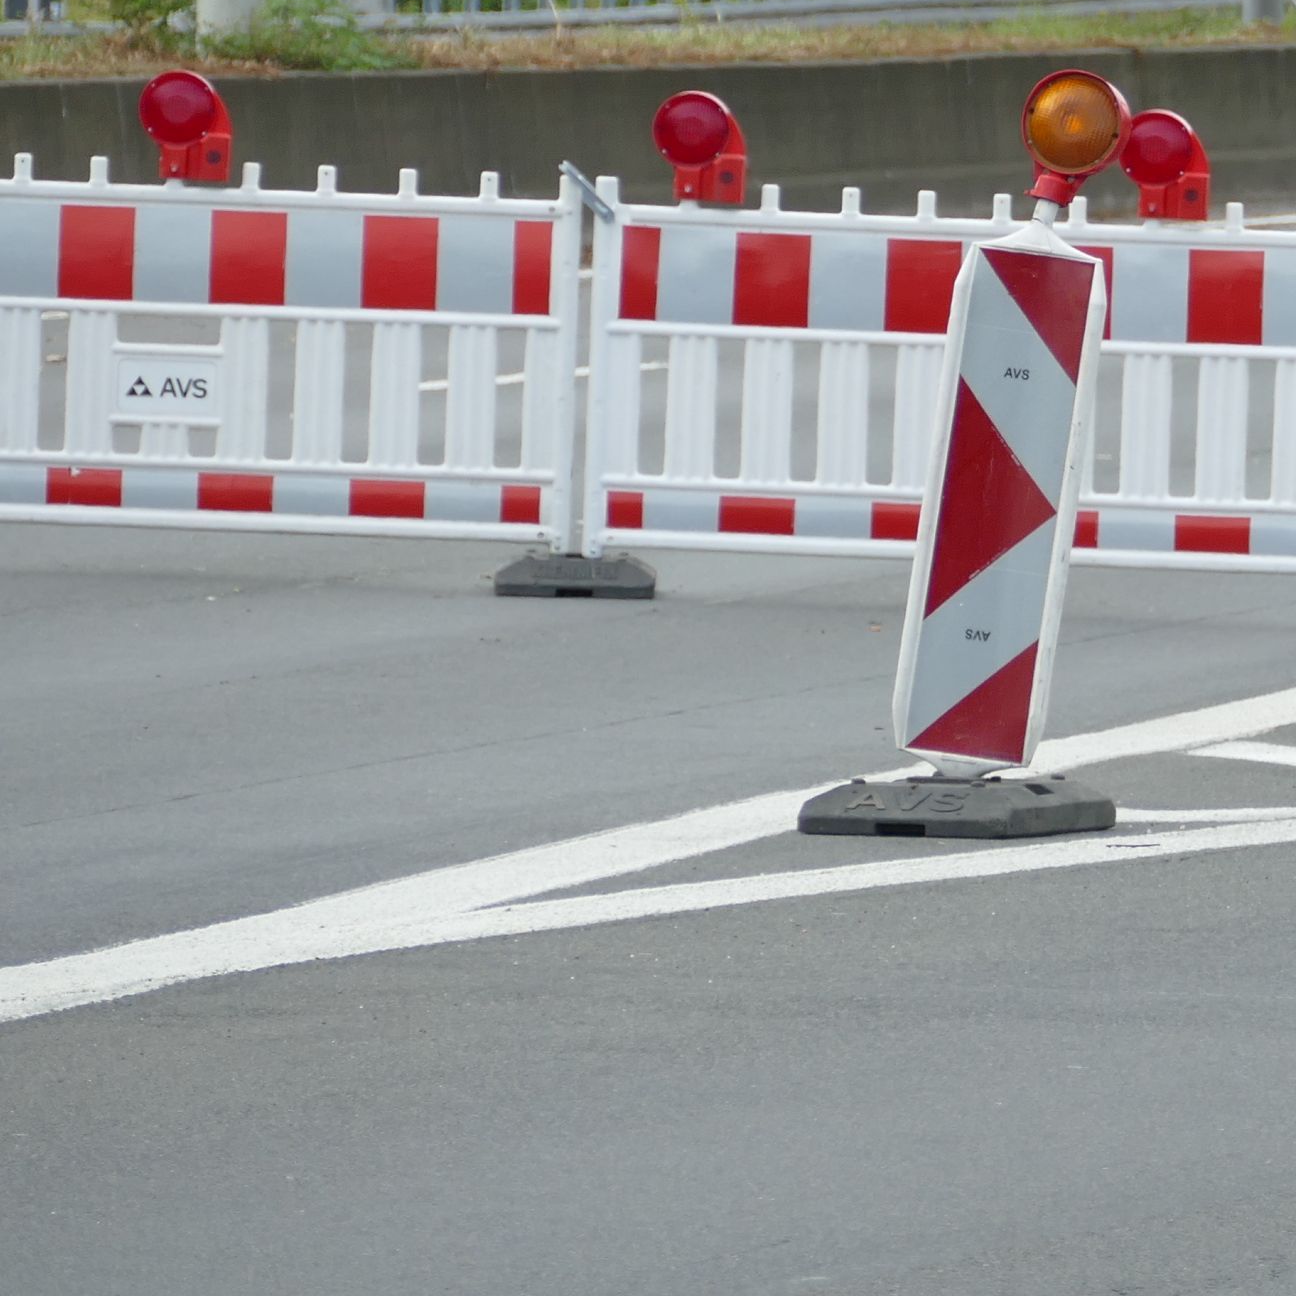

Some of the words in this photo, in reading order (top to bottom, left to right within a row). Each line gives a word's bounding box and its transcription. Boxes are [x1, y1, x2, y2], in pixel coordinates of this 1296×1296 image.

[1003, 367, 1030, 381] AVS
[159, 376, 208, 399] AVS
[964, 628, 992, 642] AVS
[844, 790, 972, 816] AVS
